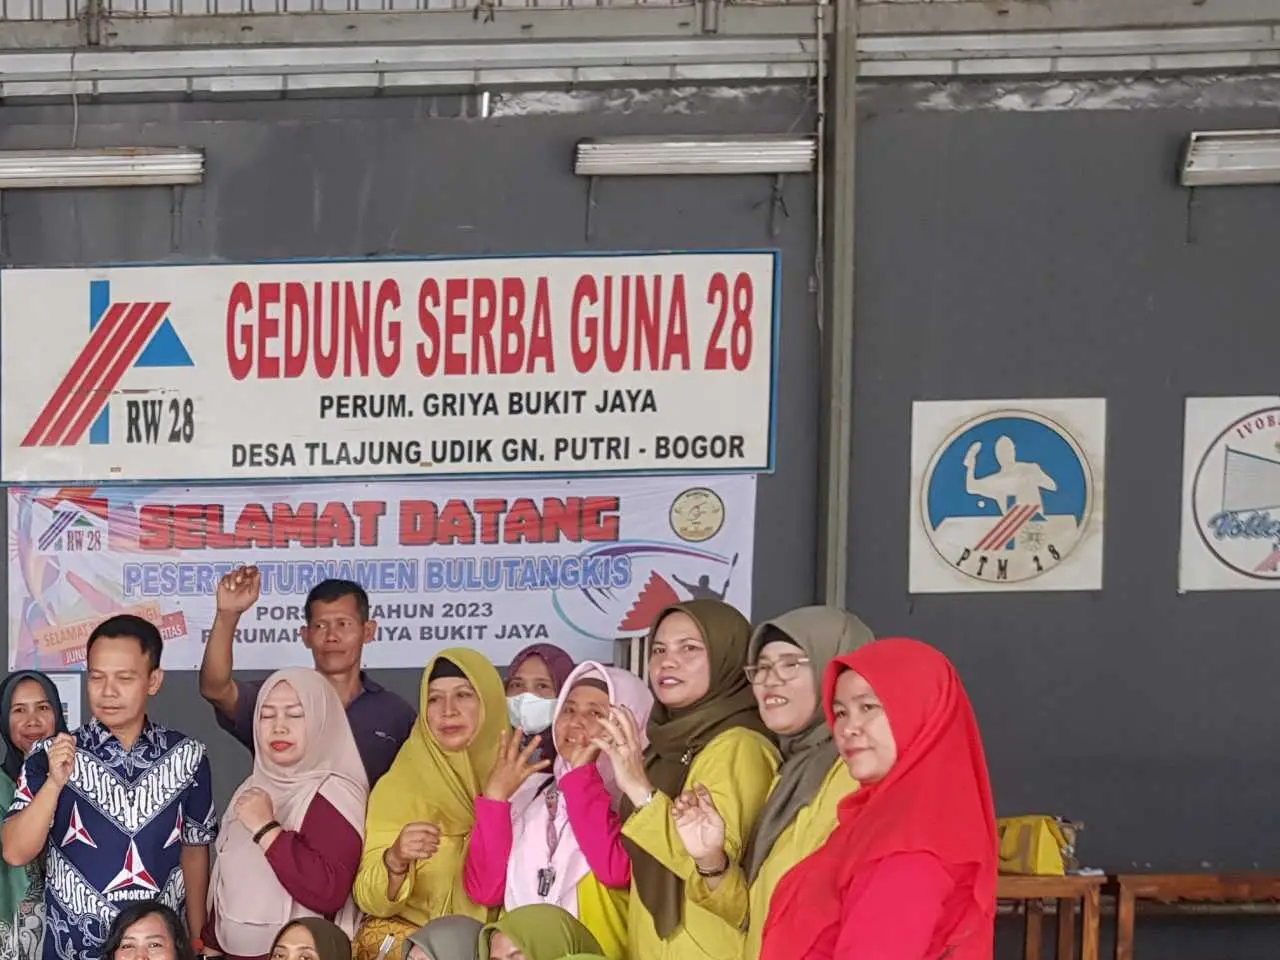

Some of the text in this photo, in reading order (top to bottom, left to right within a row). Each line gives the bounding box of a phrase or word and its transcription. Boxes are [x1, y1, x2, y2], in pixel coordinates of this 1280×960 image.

[226, 272, 754, 380] GEDUNG SERBA GUNA 28
[319, 388, 658, 419] PERUM. GRIYA BUKIT JAYA
[126, 398, 194, 445] RW 28
[231, 442, 296, 468] DESA
[305, 440, 422, 467] TLAJUNG
[431, 438, 494, 464] UDIK
[502, 437, 545, 462] GN.
[555, 436, 631, 461] PUTRI
[655, 434, 745, 460] BOGOR
[137, 497, 621, 550] SELAMAT DATANG
[67, 530, 102, 551] RW 28
[123, 555, 632, 598] PESERT TURNAMEN BULUTANGKIS
[955, 547, 1009, 580] PTM
[368, 603, 434, 619] AHUN
[442, 602, 493, 618] 2023
[420, 625, 488, 641] BUKIT
[495, 624, 549, 640] JAYA
